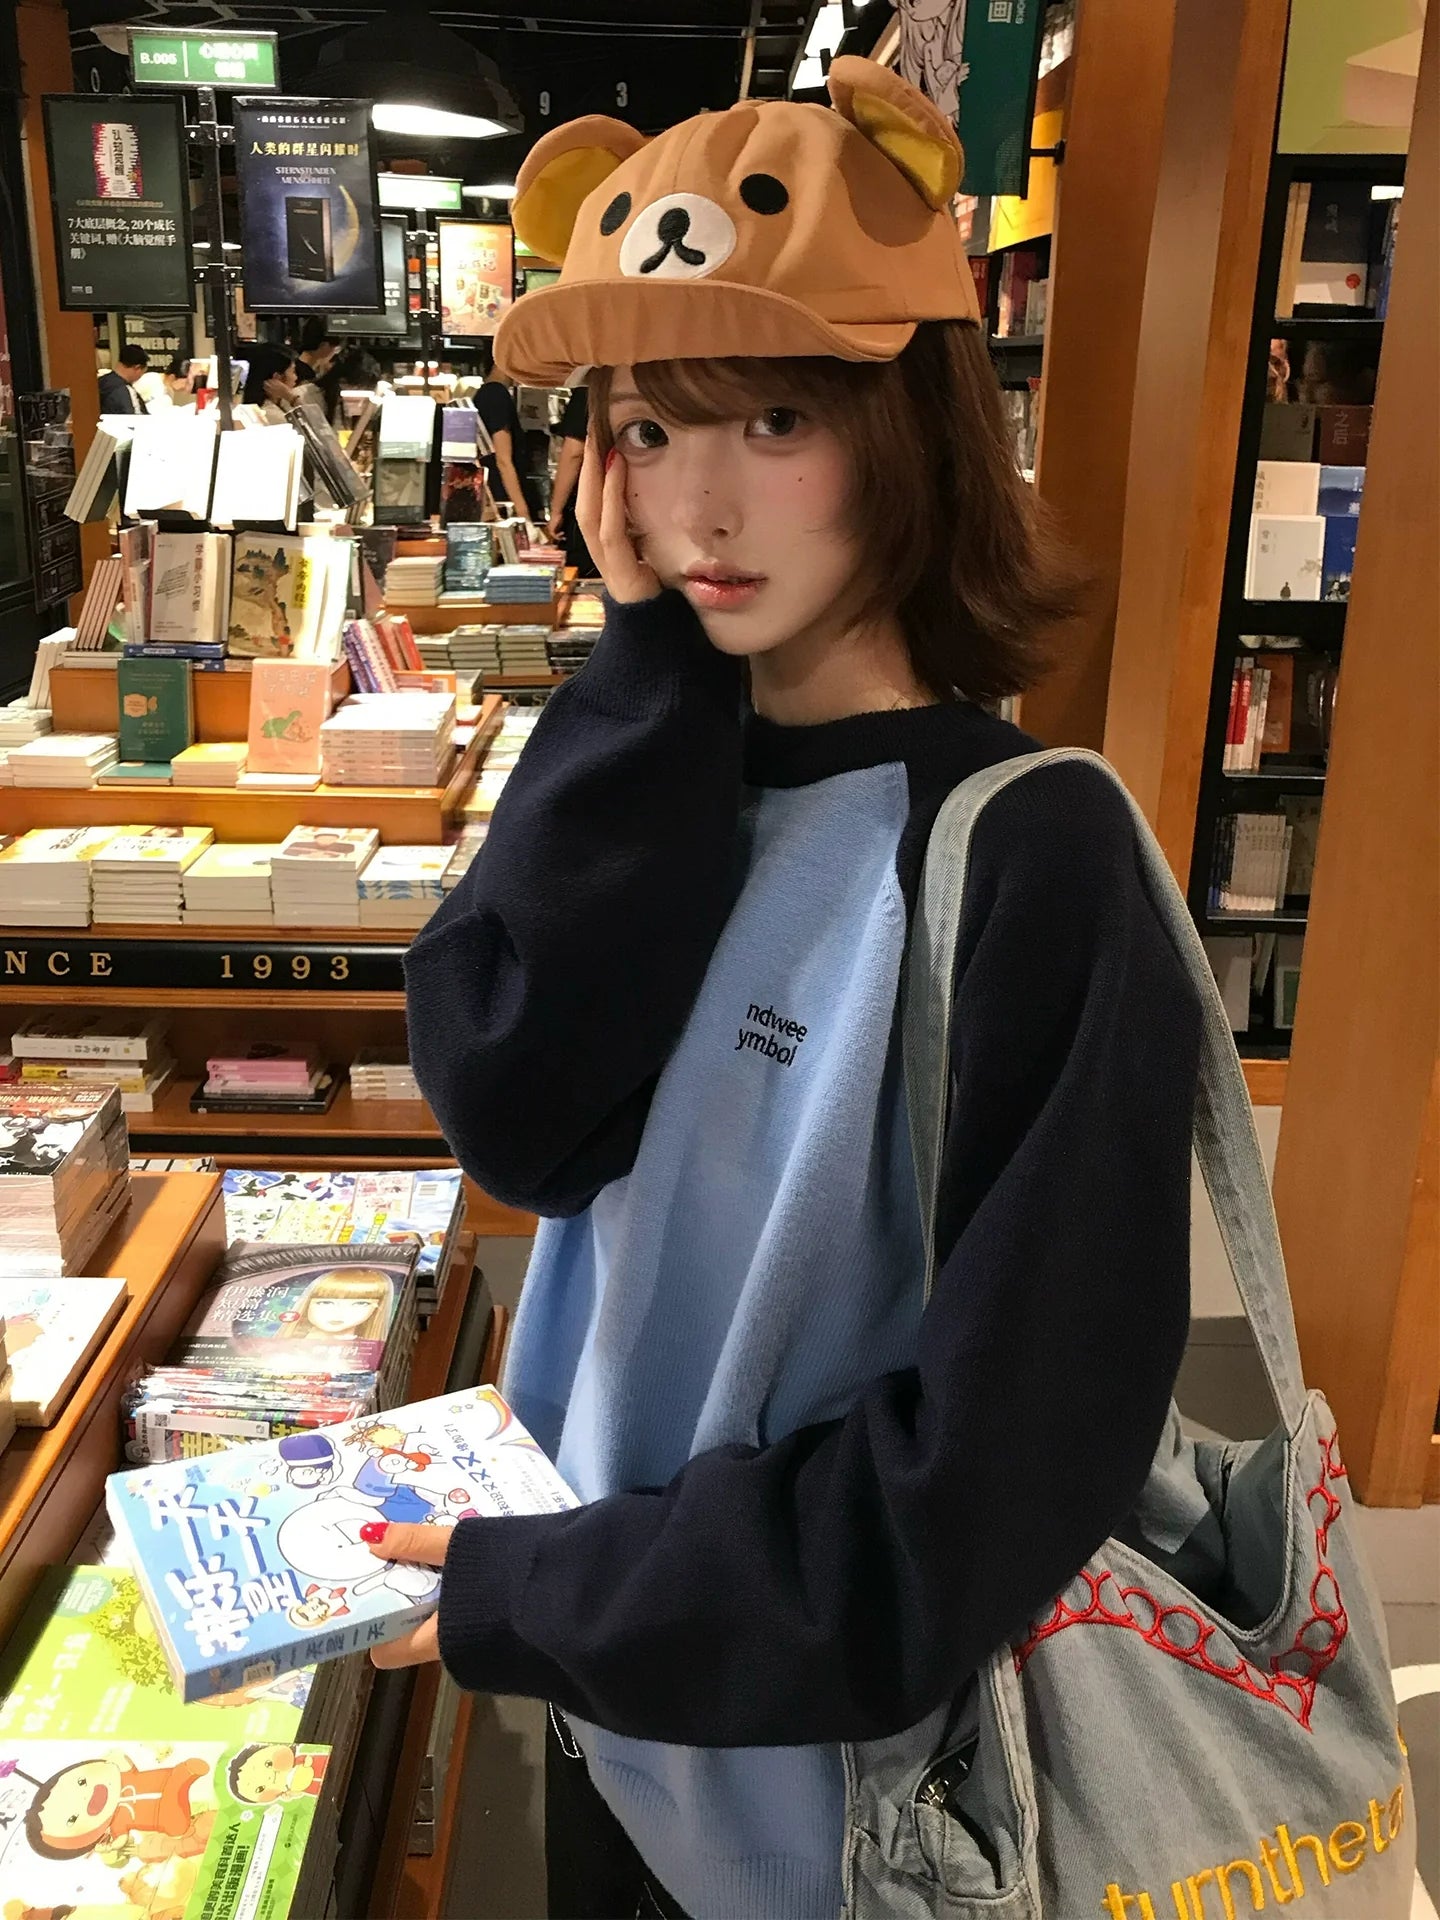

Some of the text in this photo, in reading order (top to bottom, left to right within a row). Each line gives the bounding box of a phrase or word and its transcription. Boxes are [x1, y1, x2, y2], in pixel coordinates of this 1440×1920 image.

[1014, 0, 1026, 24] OKS
[250, 141, 359, 156] 人类的群星闪耀时
[221, 955, 349, 979] 1993
[747, 1003, 808, 1042] ndwee
[735, 1028, 798, 1067] ymbol
